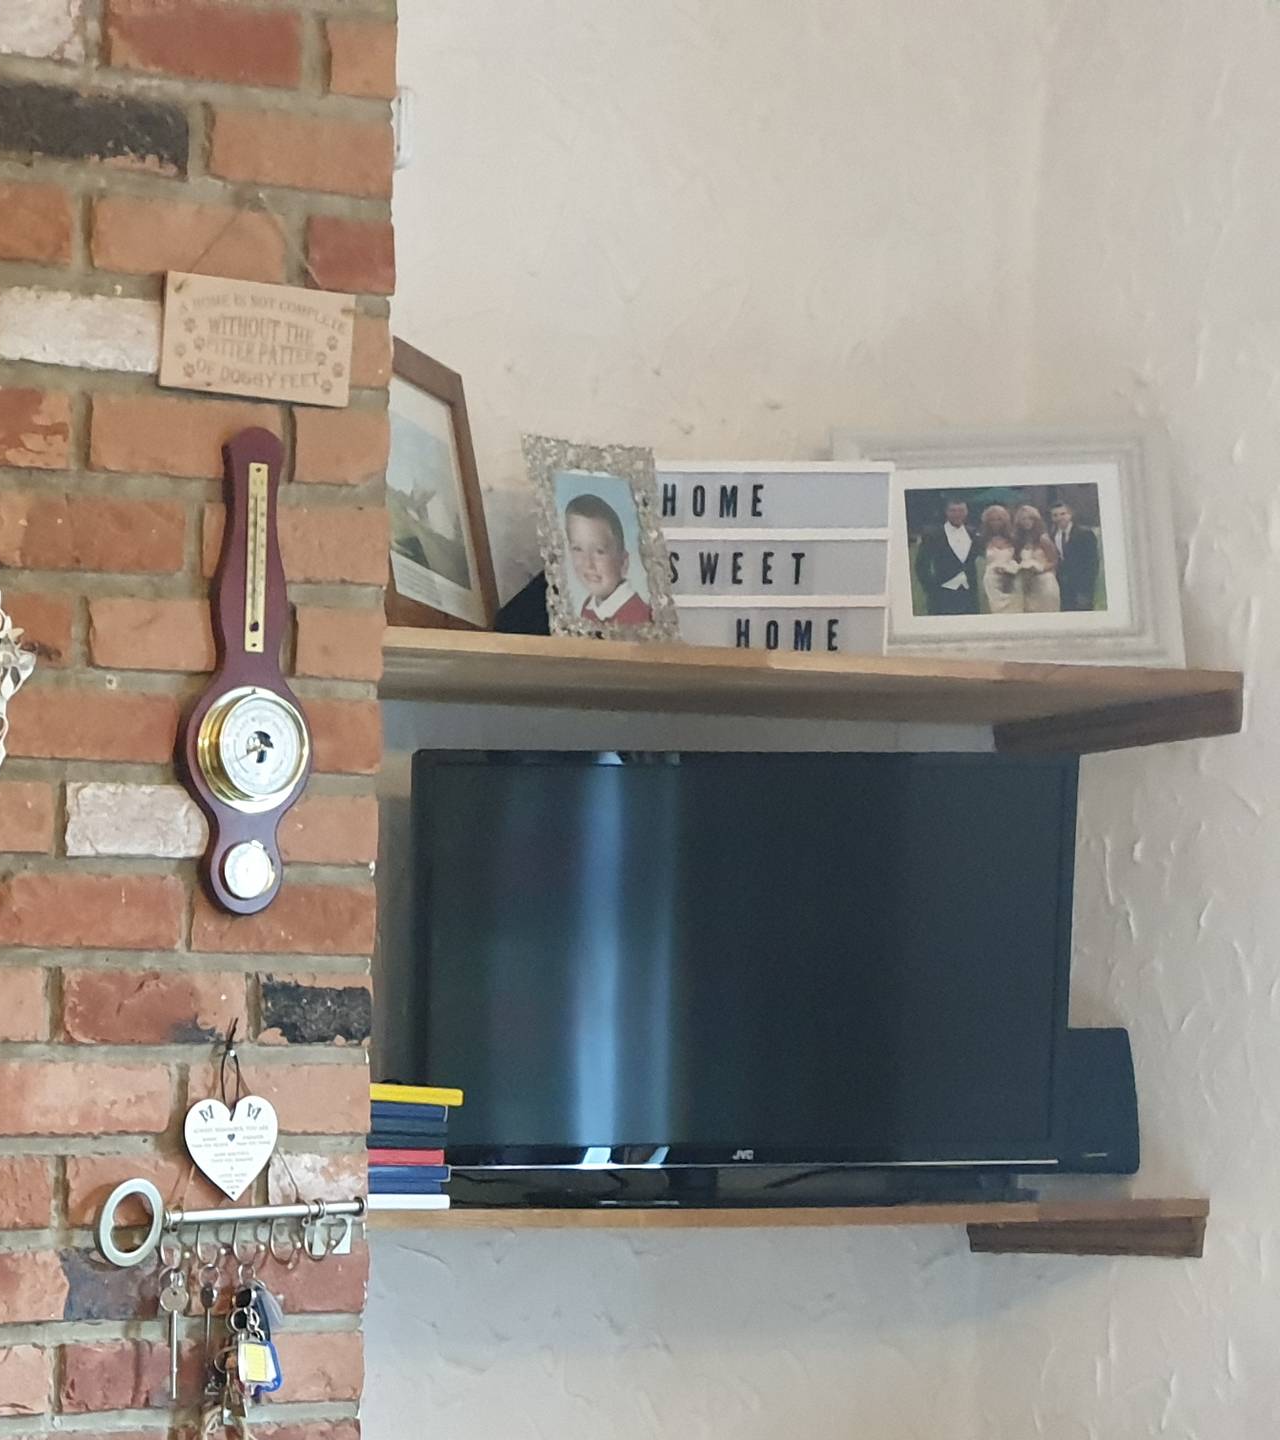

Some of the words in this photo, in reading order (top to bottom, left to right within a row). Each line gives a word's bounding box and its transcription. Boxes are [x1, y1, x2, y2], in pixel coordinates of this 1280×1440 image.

[208, 315, 281, 343] WITHOUT
[662, 483, 763, 518] HOME
[668, 551, 805, 585] SWEET
[736, 618, 839, 652] HOME
[732, 1149, 753, 1160] JVC
